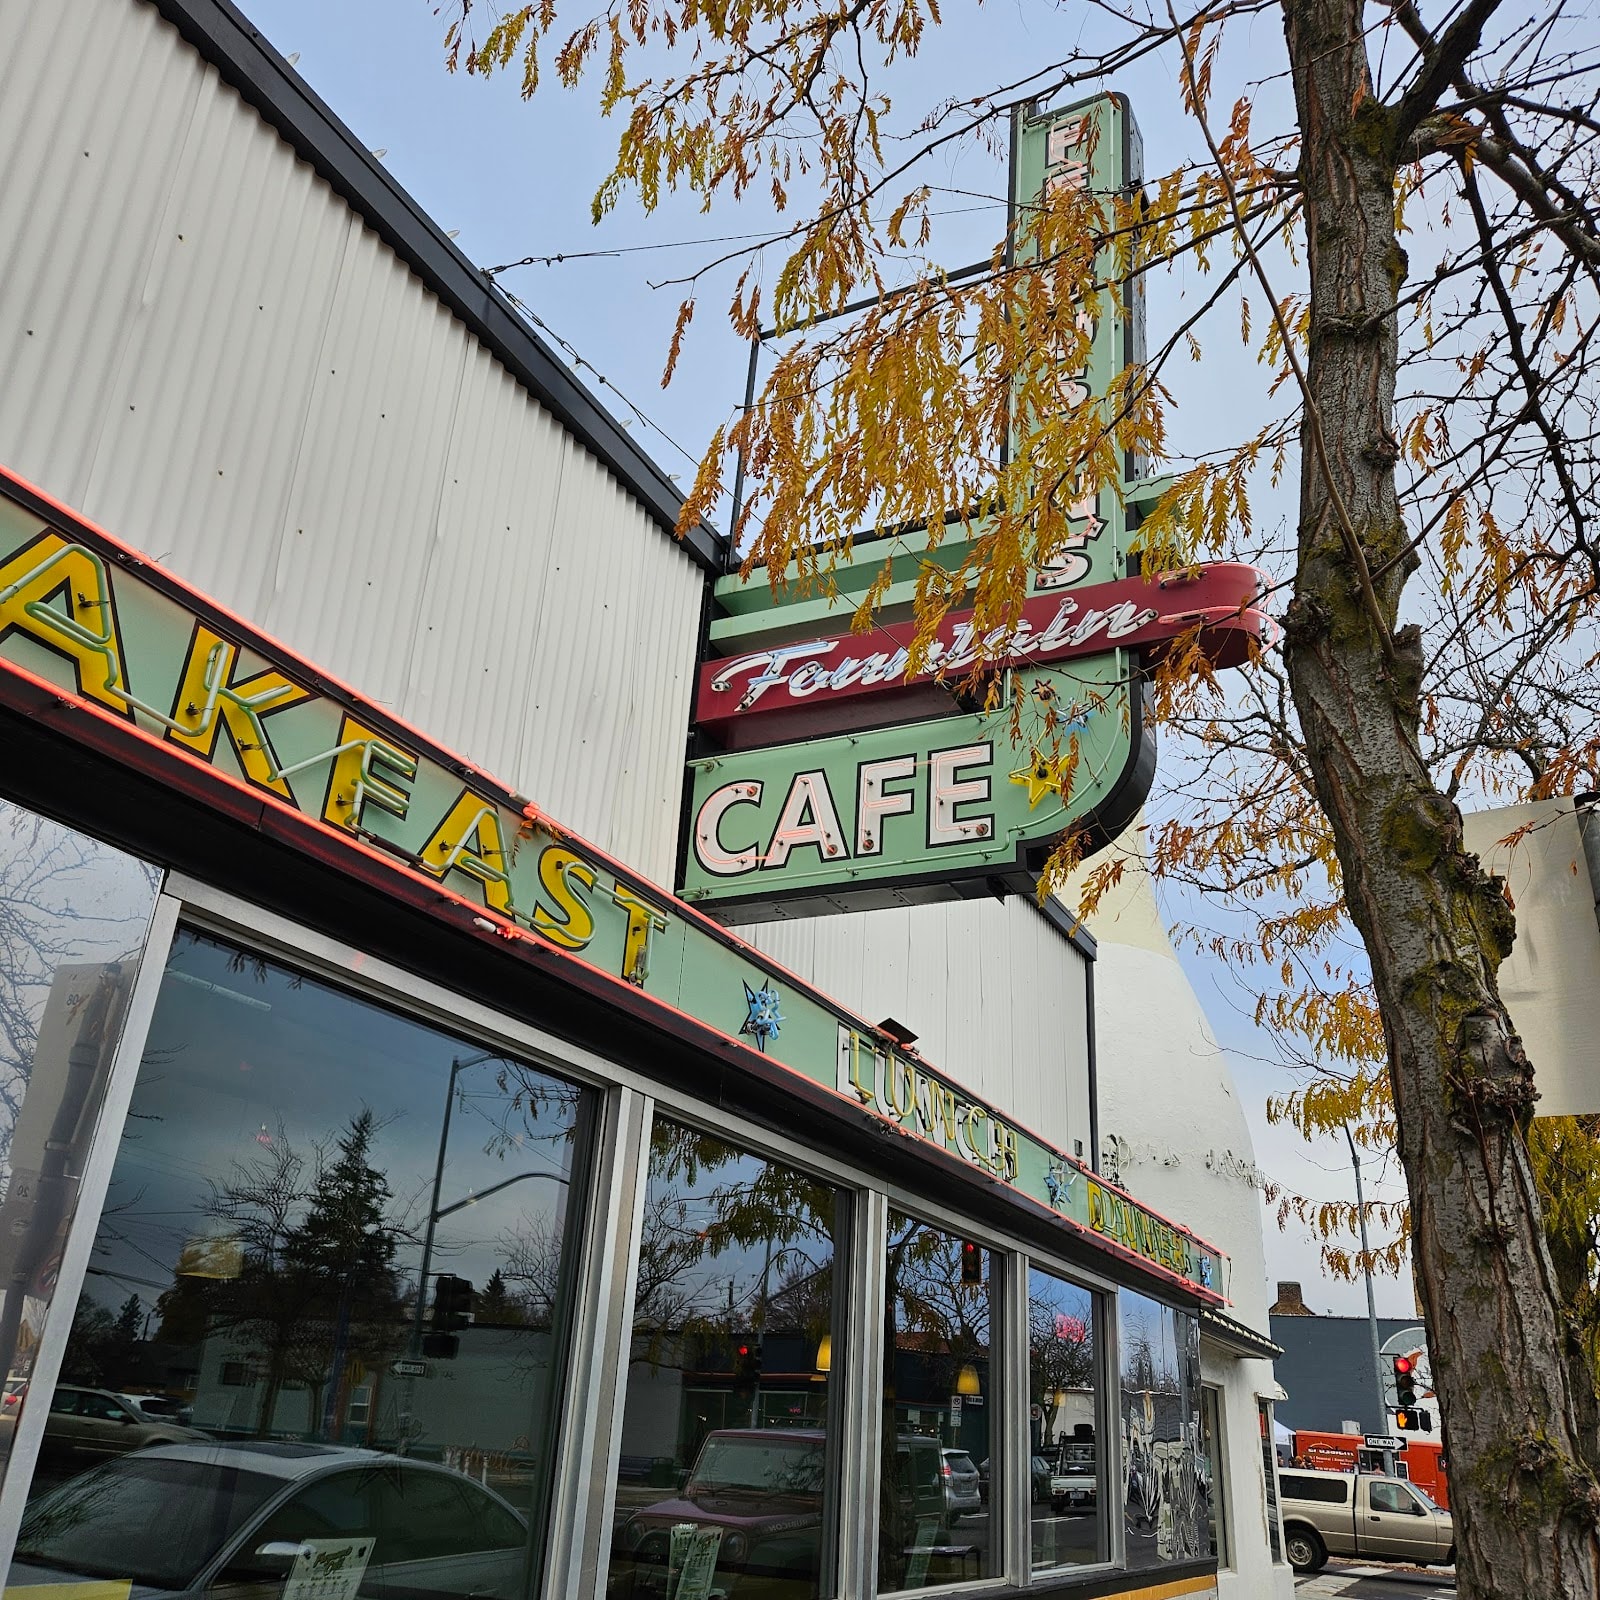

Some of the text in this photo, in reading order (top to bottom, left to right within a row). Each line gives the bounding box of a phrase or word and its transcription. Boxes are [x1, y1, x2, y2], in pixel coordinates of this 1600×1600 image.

[693, 741, 995, 876] CAFE
[836, 1021, 1018, 1183] LUNCH
[1087, 1179, 1192, 1277] DINNER
